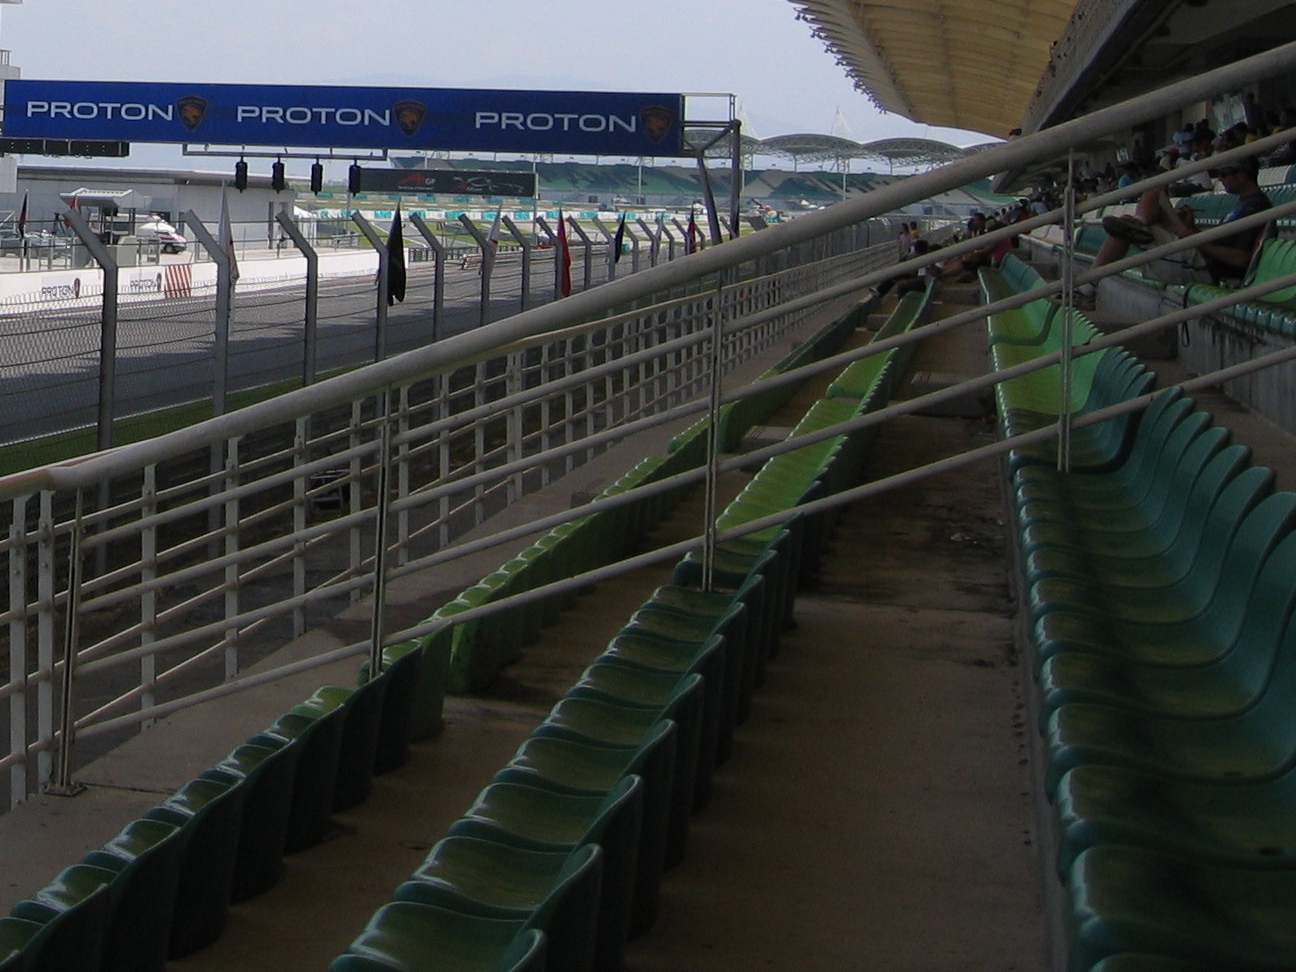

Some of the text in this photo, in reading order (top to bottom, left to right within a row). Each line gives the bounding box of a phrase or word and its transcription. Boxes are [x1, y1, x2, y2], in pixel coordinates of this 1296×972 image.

[27, 100, 173, 122] PROTON
[236, 105, 391, 127] PROTON
[474, 111, 637, 133] PROTON
